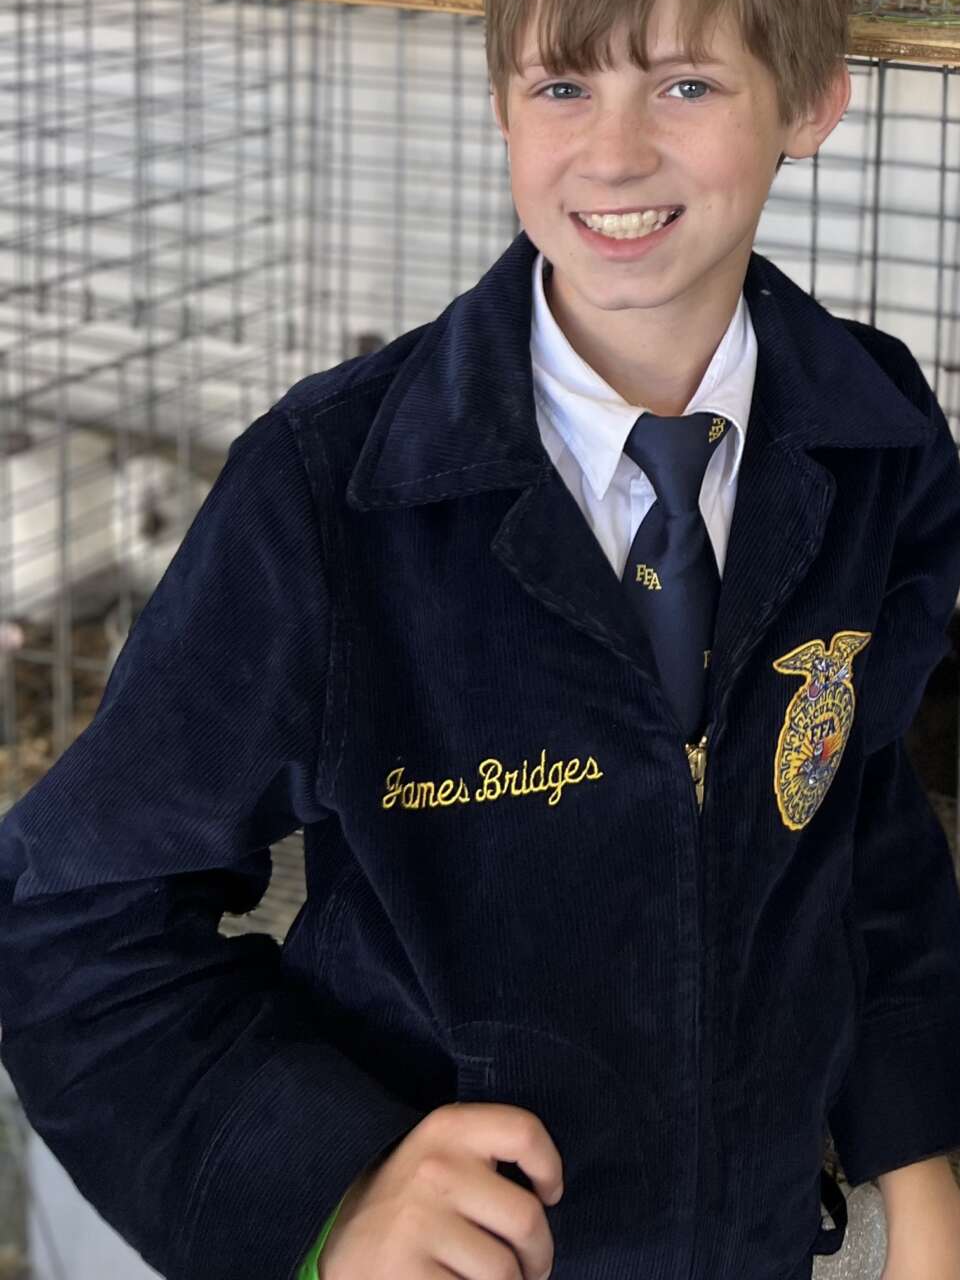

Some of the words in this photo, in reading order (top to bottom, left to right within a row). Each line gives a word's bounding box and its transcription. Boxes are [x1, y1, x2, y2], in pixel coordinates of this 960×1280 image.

[635, 564, 662, 590] FFA
[810, 717, 836, 744] FFA
[382, 766, 470, 809] James
[475, 748, 604, 807] Bridges
